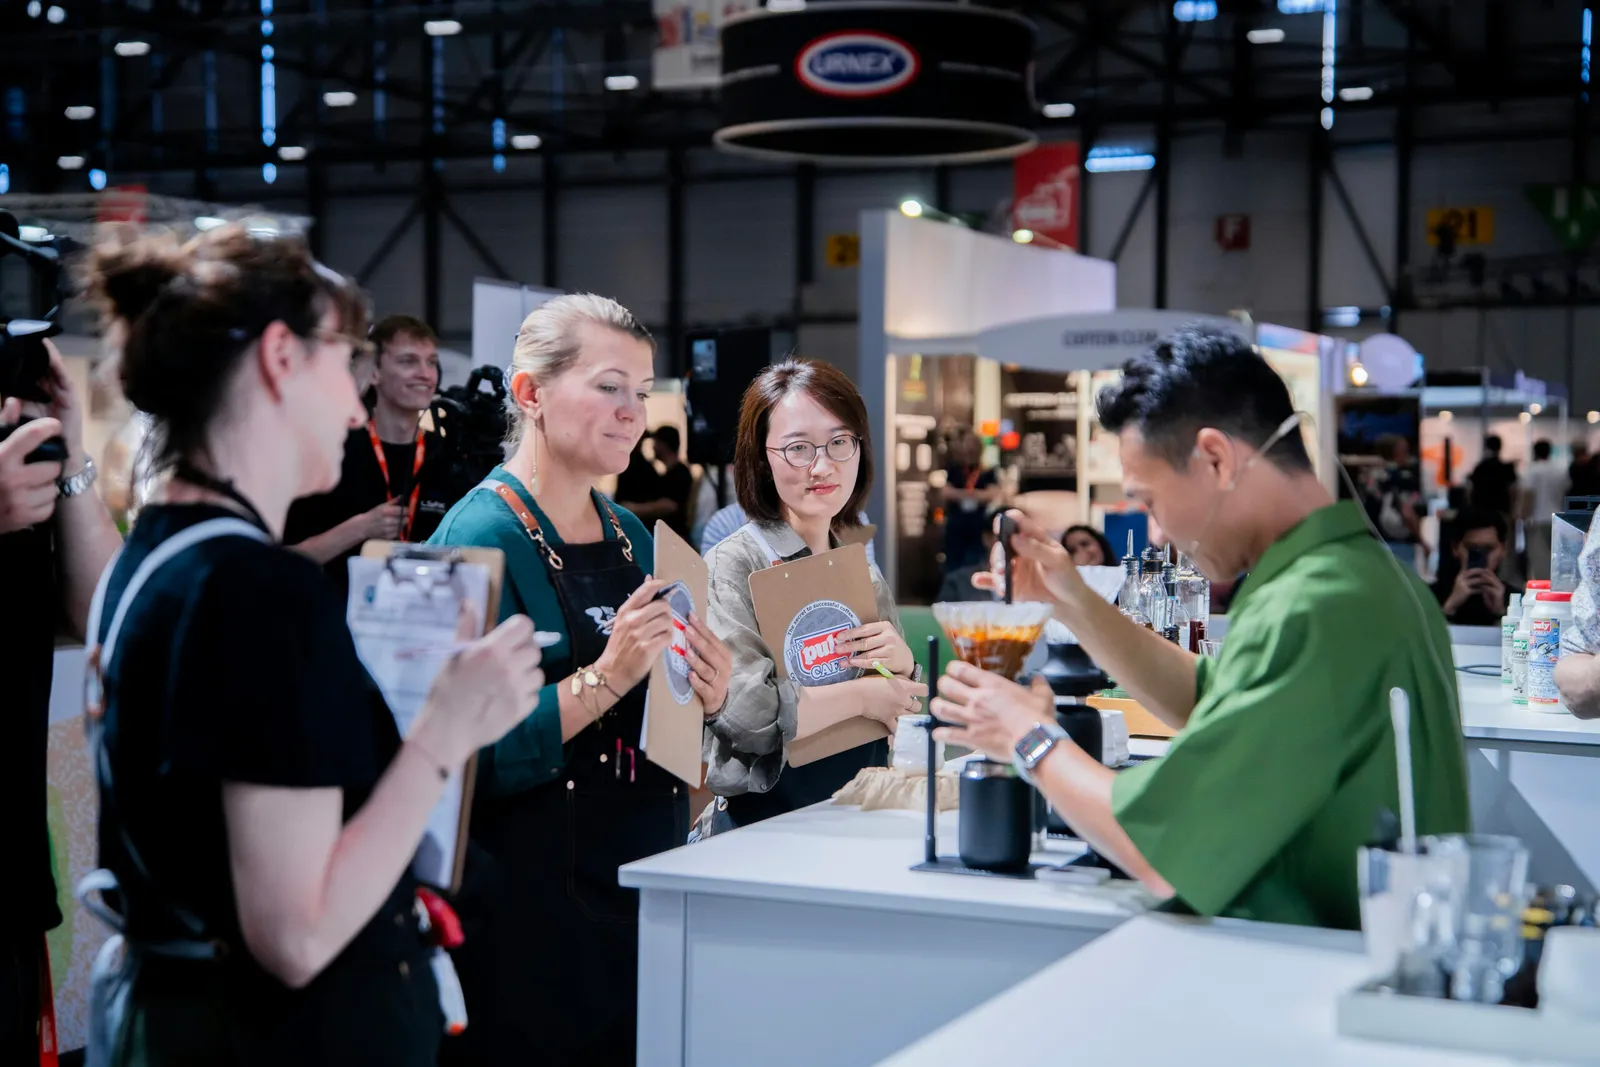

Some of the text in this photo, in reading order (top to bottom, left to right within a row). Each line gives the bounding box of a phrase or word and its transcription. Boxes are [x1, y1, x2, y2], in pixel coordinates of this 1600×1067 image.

[787, 601, 854, 636] The secret to successful coffee
